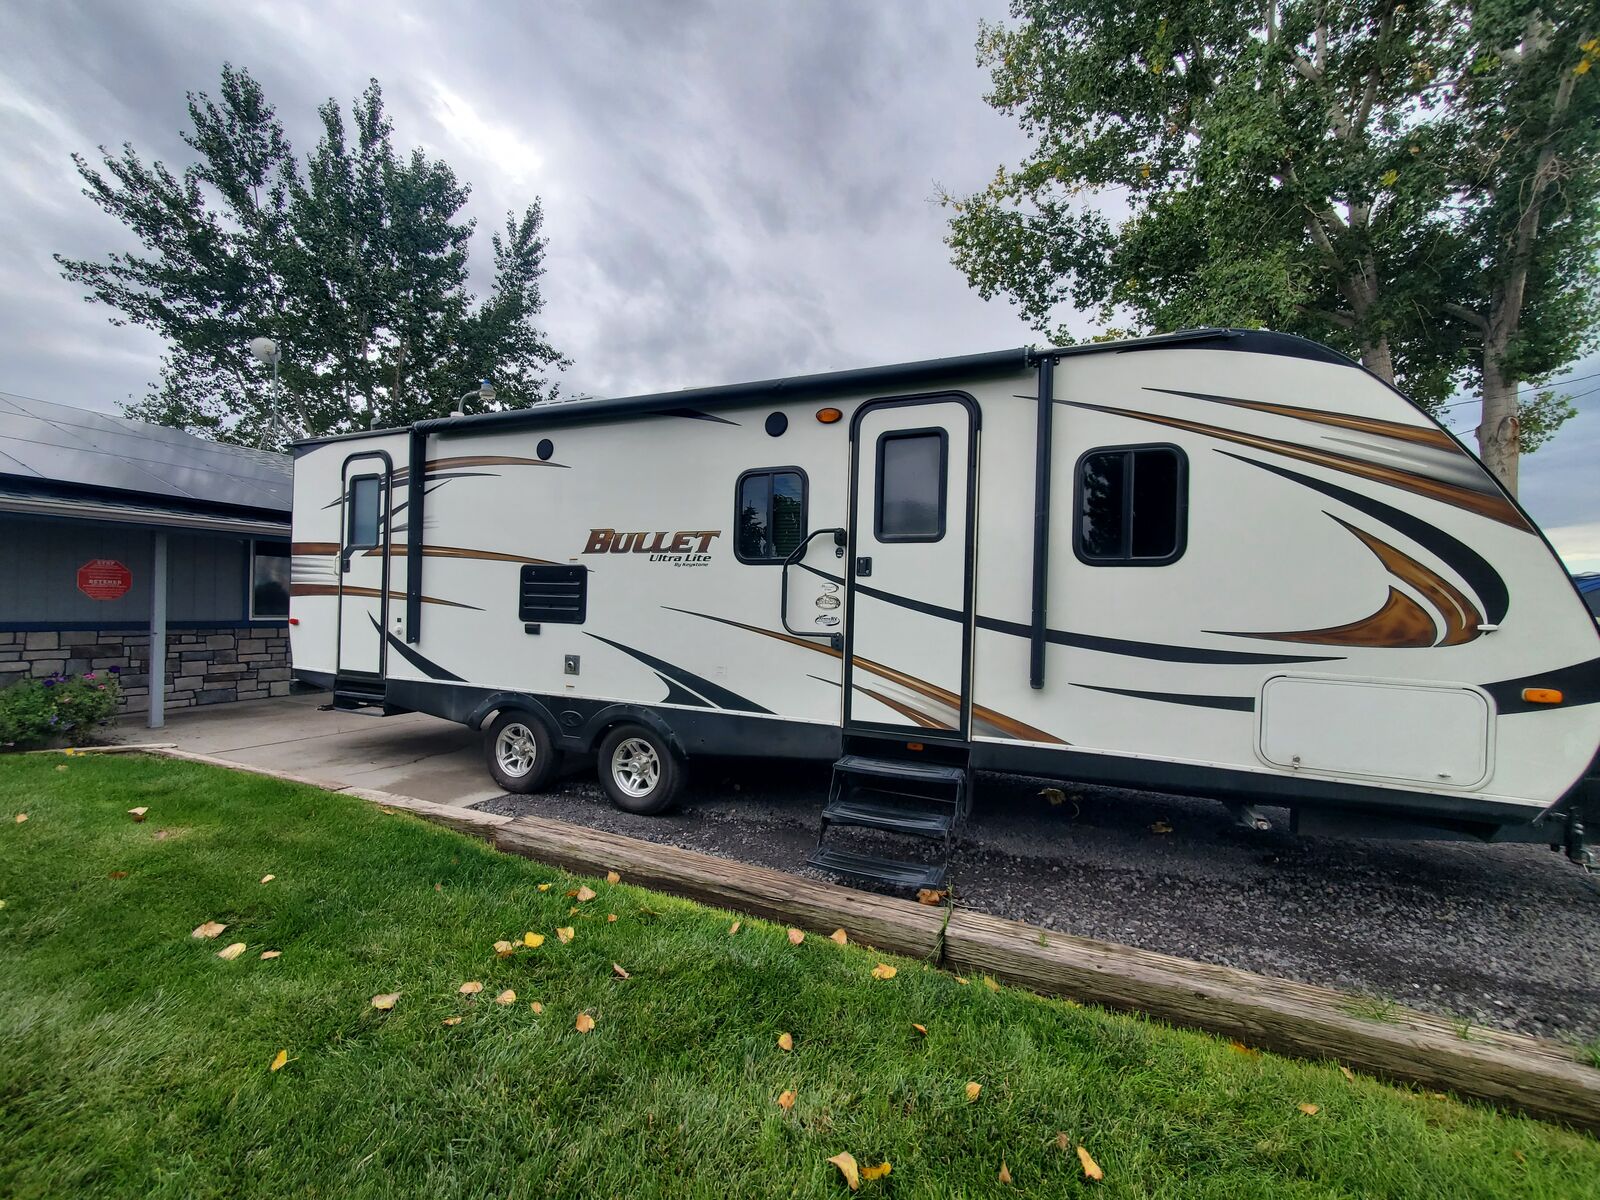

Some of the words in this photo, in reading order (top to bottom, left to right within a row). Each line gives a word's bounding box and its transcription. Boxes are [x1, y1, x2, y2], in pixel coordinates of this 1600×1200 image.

[582, 529, 721, 554] BULLET
[649, 554, 682, 562] Ultra
[685, 554, 712, 562] Lite
